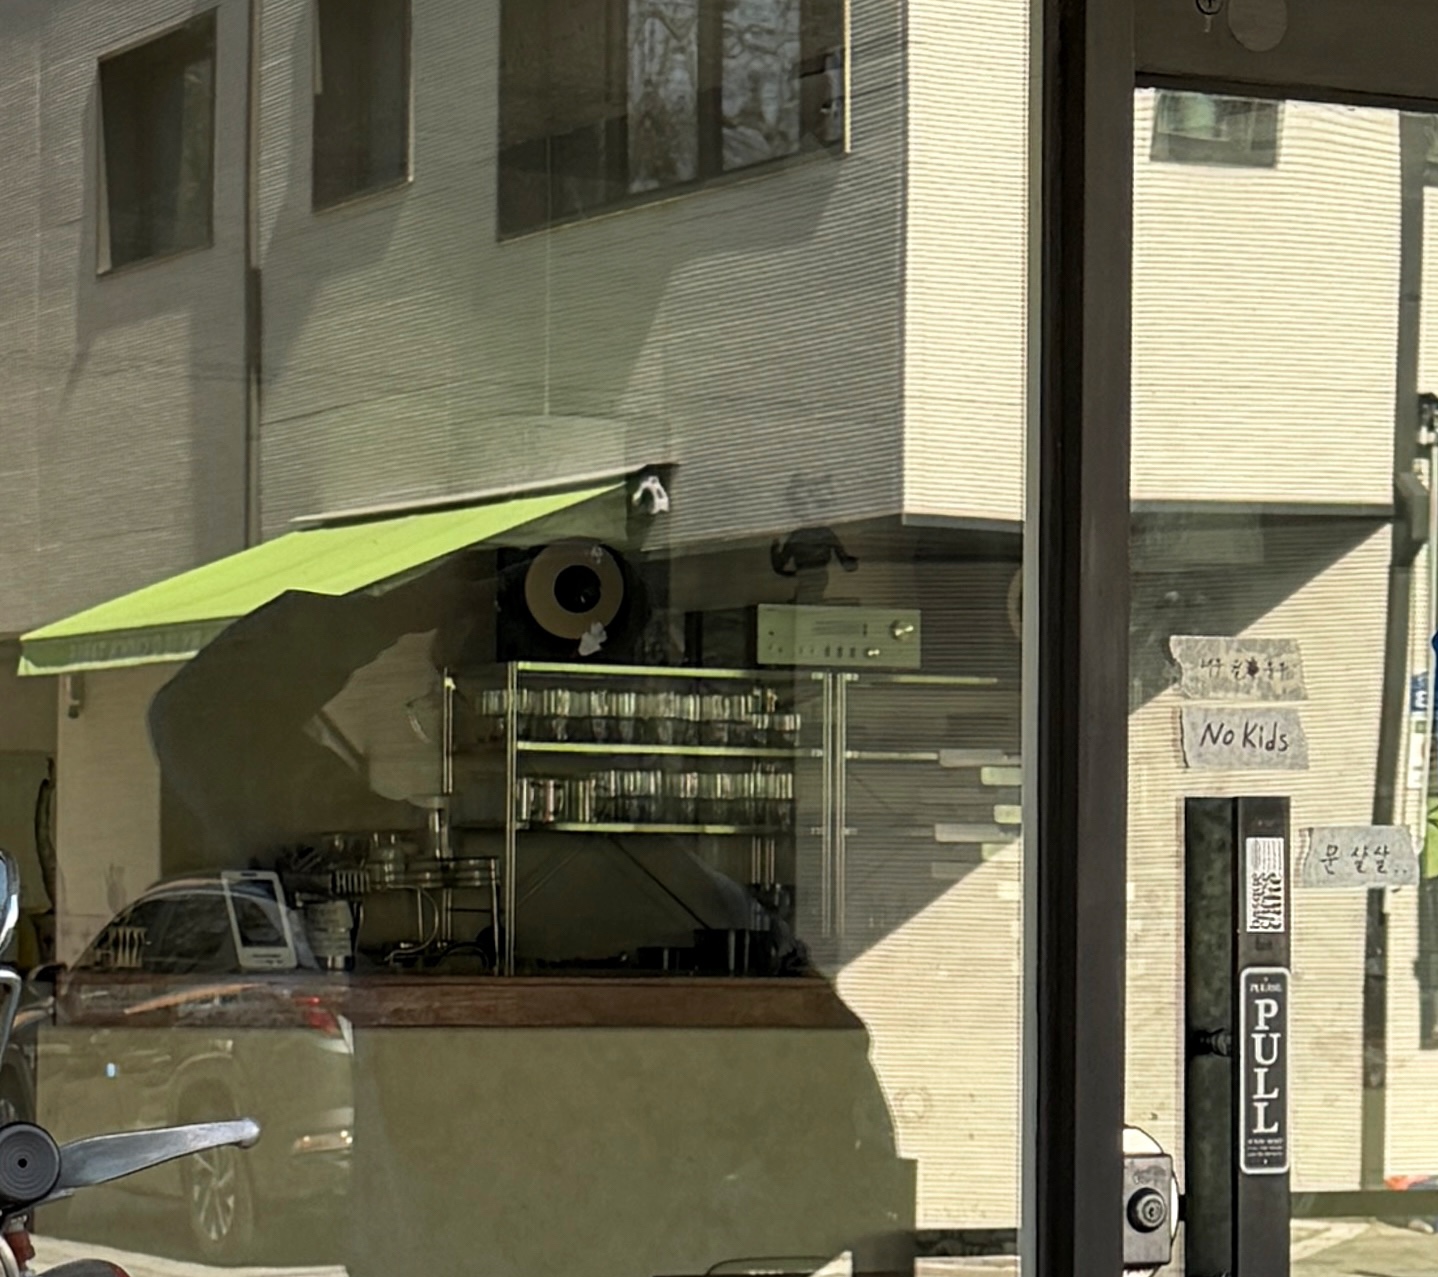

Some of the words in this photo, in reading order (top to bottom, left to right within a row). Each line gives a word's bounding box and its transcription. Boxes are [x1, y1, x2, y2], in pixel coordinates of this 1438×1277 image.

[1200, 722, 1235, 747] No
[1242, 721, 1289, 752] Kids
[1320, 844, 1340, 875] 문
[1250, 998, 1282, 1134] PULL
